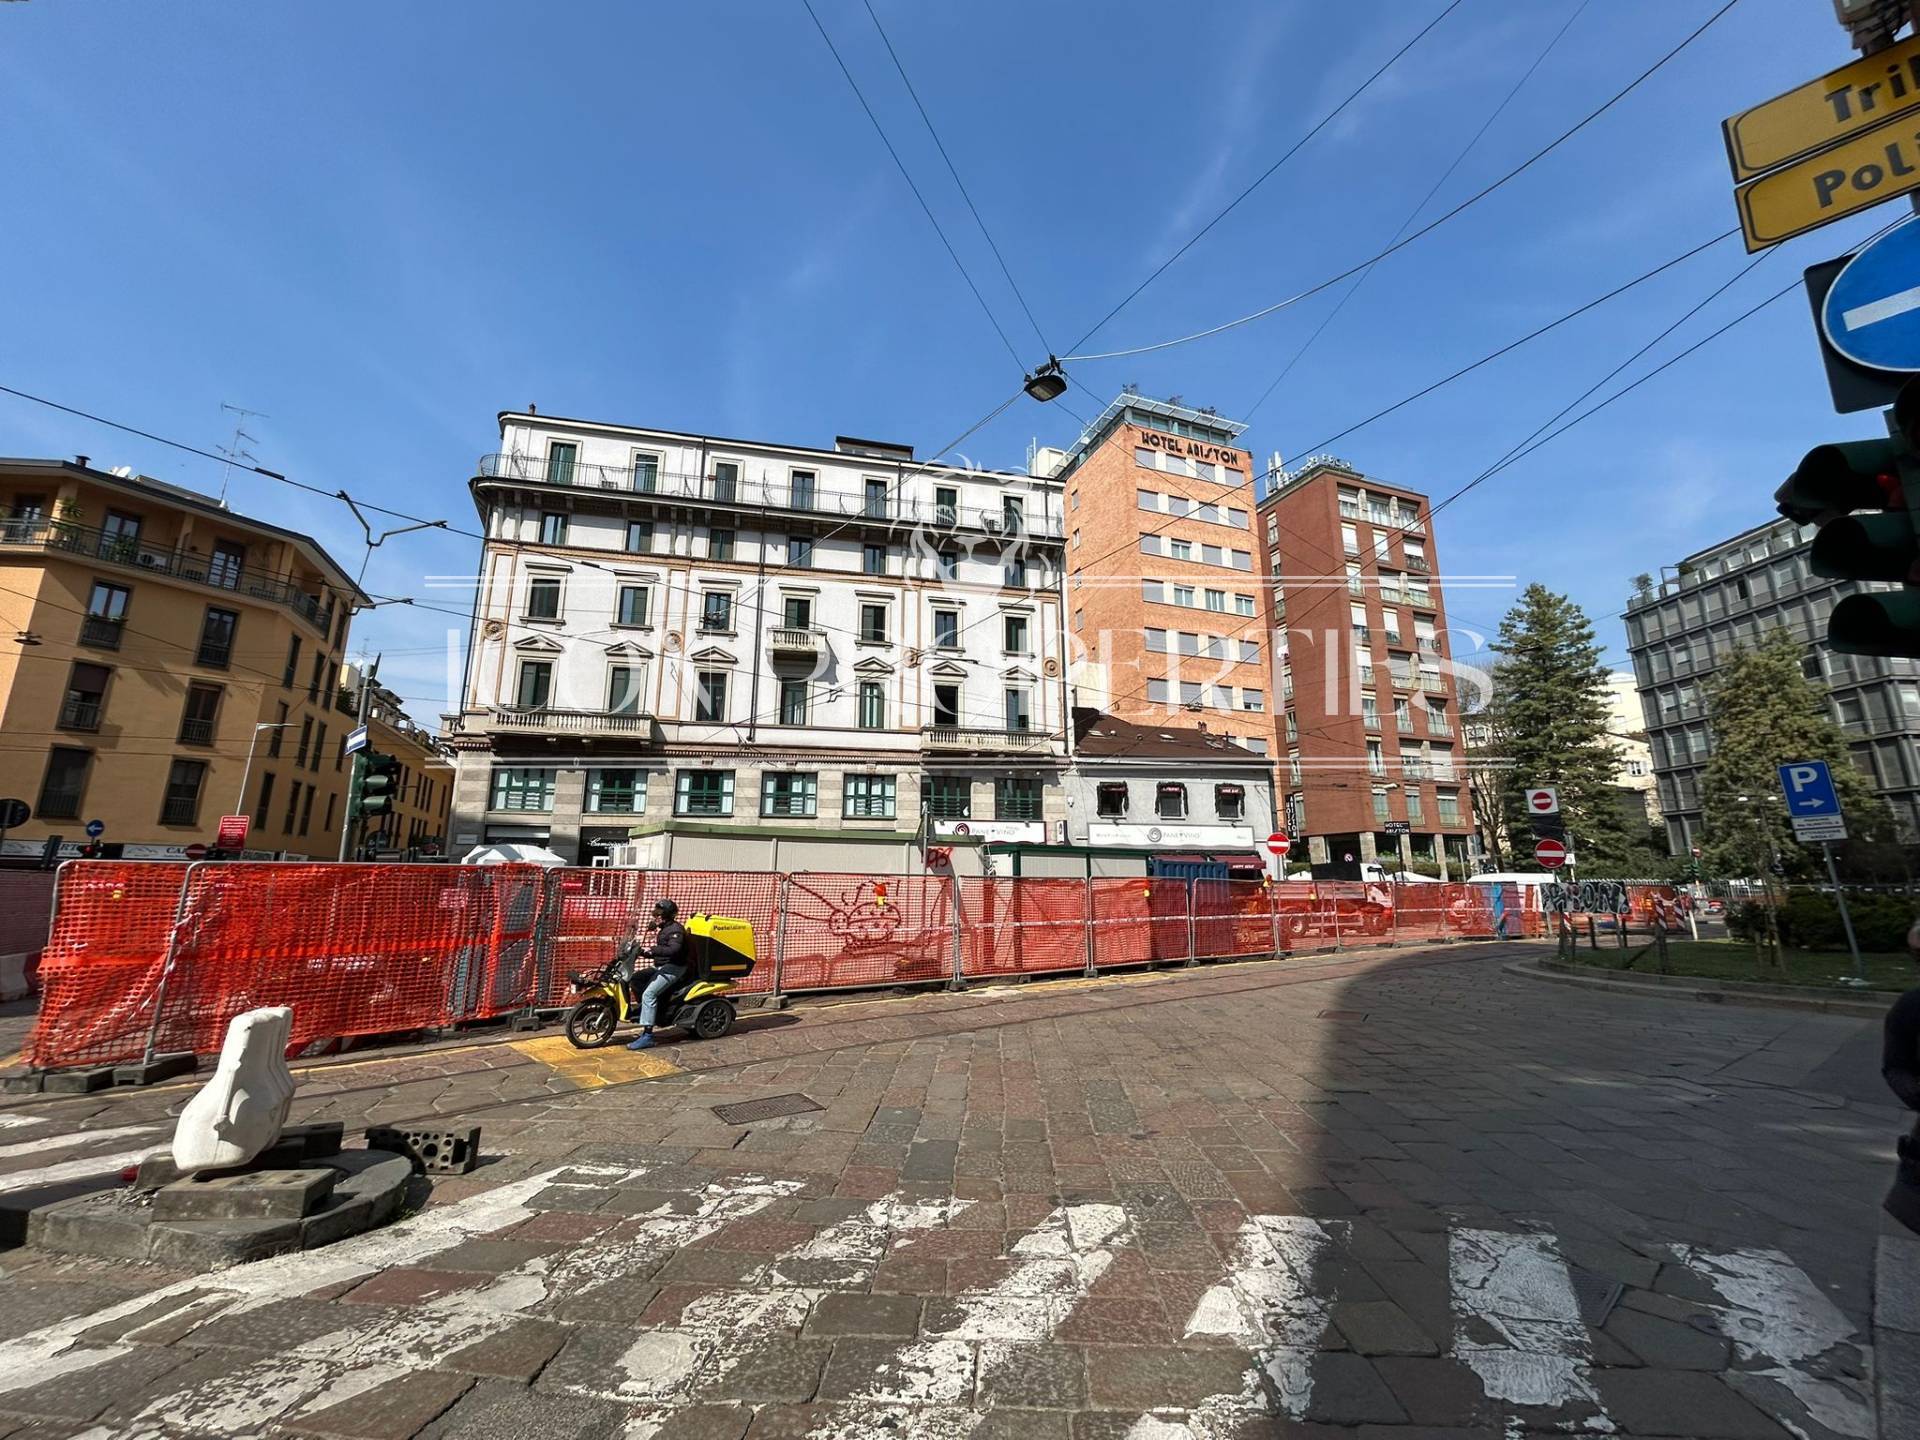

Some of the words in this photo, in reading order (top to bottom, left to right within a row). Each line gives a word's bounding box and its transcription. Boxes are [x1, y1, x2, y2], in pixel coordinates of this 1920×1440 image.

[1142, 431, 1182, 453] HOTEL
[1187, 442, 1238, 465] ARISTON
[1789, 766, 1818, 792] P
